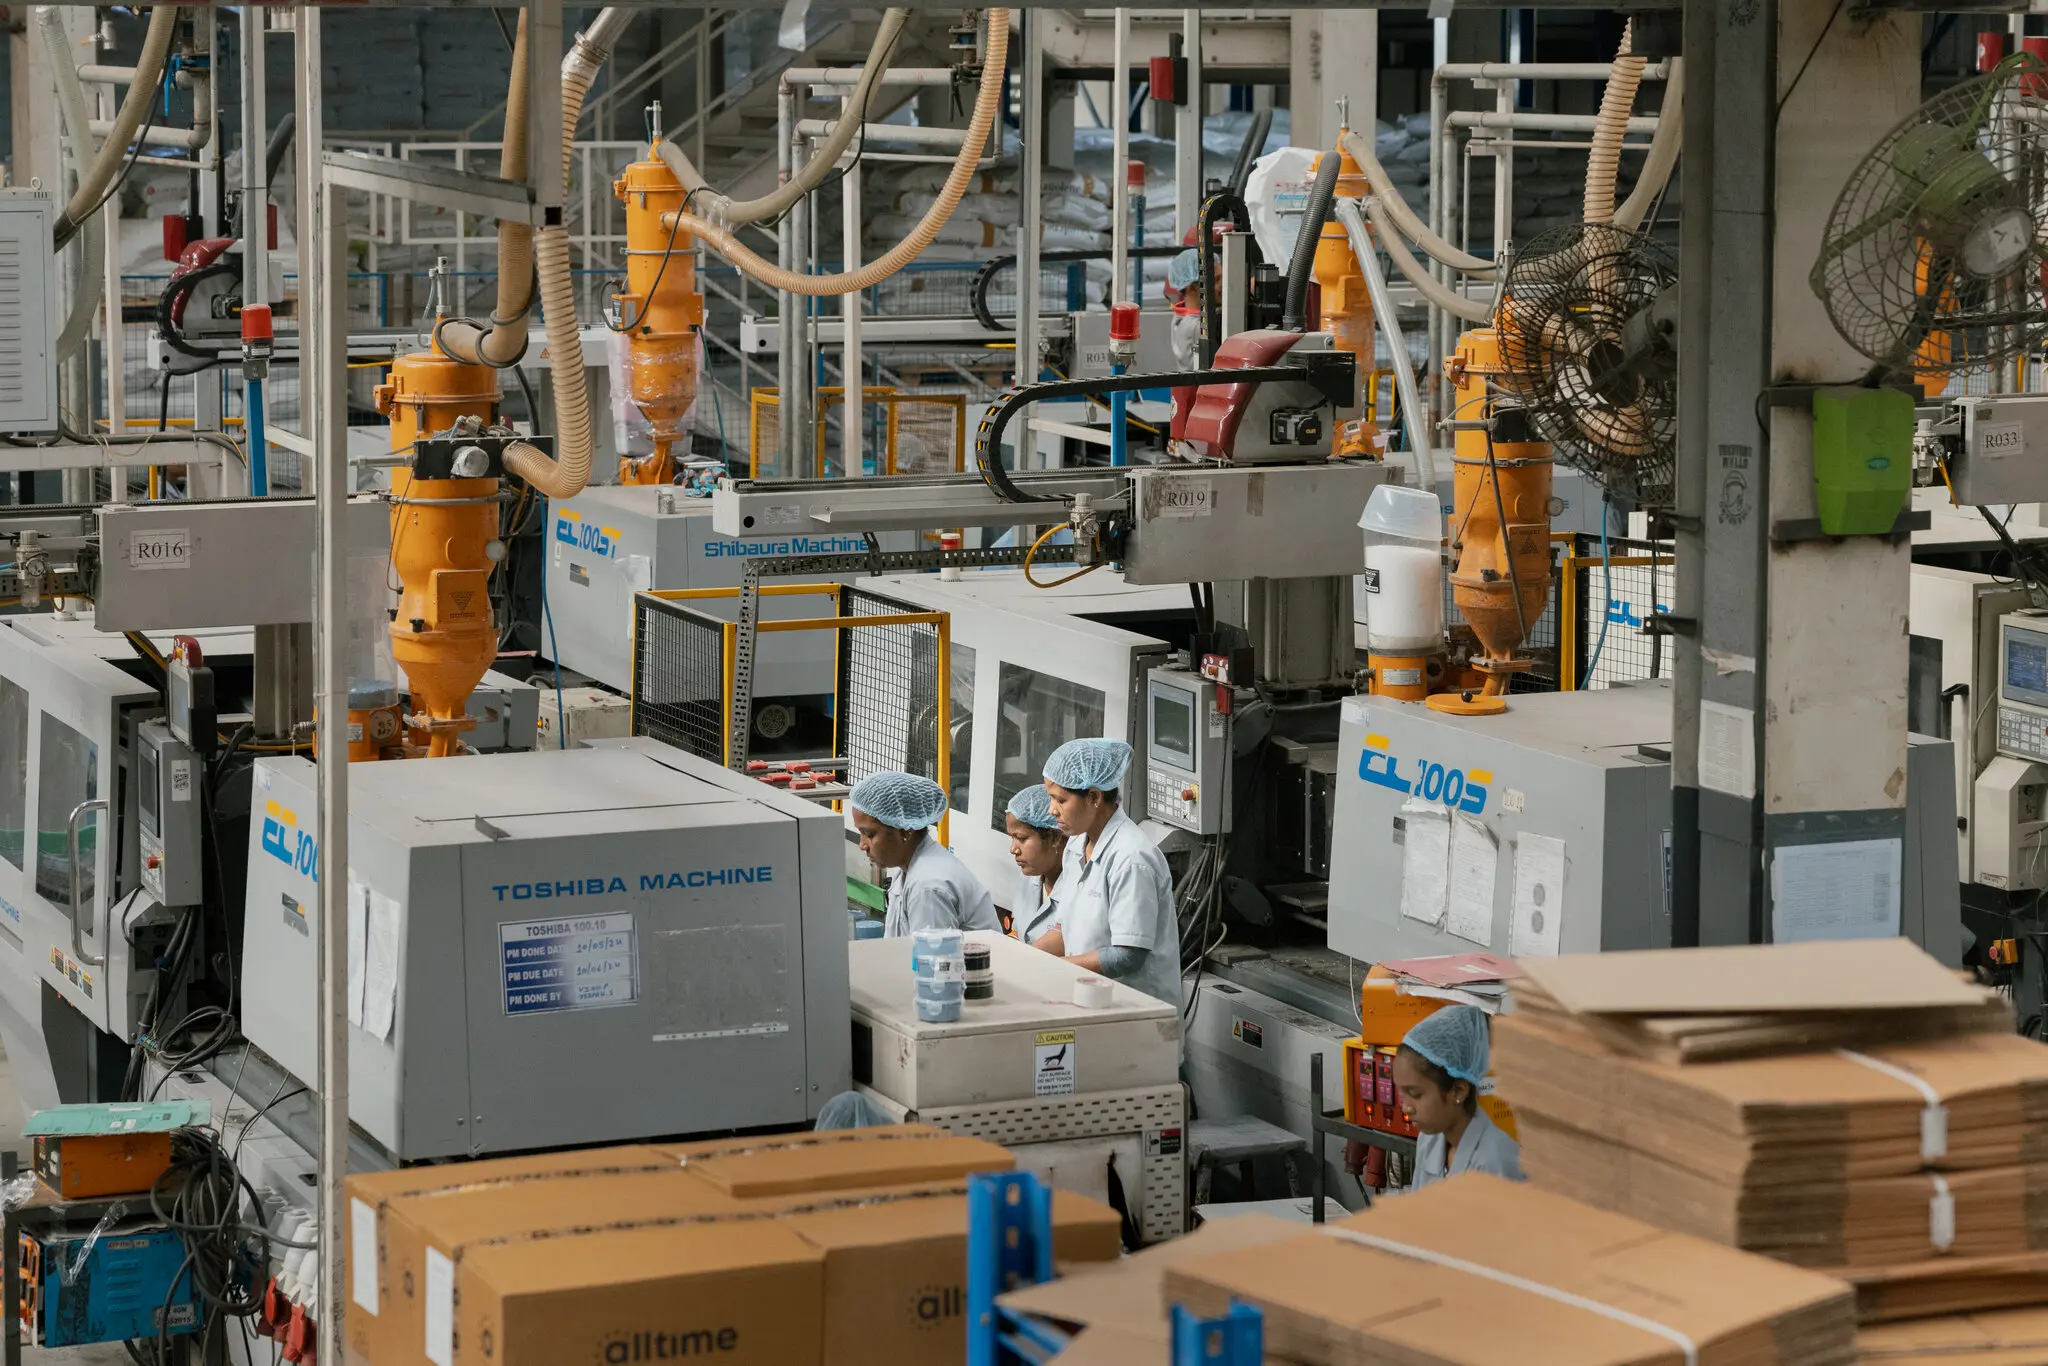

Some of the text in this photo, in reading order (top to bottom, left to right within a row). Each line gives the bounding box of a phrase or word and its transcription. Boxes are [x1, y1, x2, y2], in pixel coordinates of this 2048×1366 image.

[1086, 352, 1110, 363] R03
[1985, 431, 2017, 448] R033
[1168, 491, 1205, 506] R019
[138, 541, 183, 558] R016
[704, 537, 869, 557] Shibaura Machine
[492, 866, 773, 901] TOSHIBA MACHINE
[526, 919, 606, 937] TOSHIBA 100.10
[506, 948, 520, 959] PM
[521, 946, 546, 957] DONE
[507, 968, 565, 982] PM DUE DATE
[509, 991, 562, 1006] PM DONE BY
[1045, 1032, 1074, 1042] CAUTION
[604, 1324, 738, 1365] alltime
